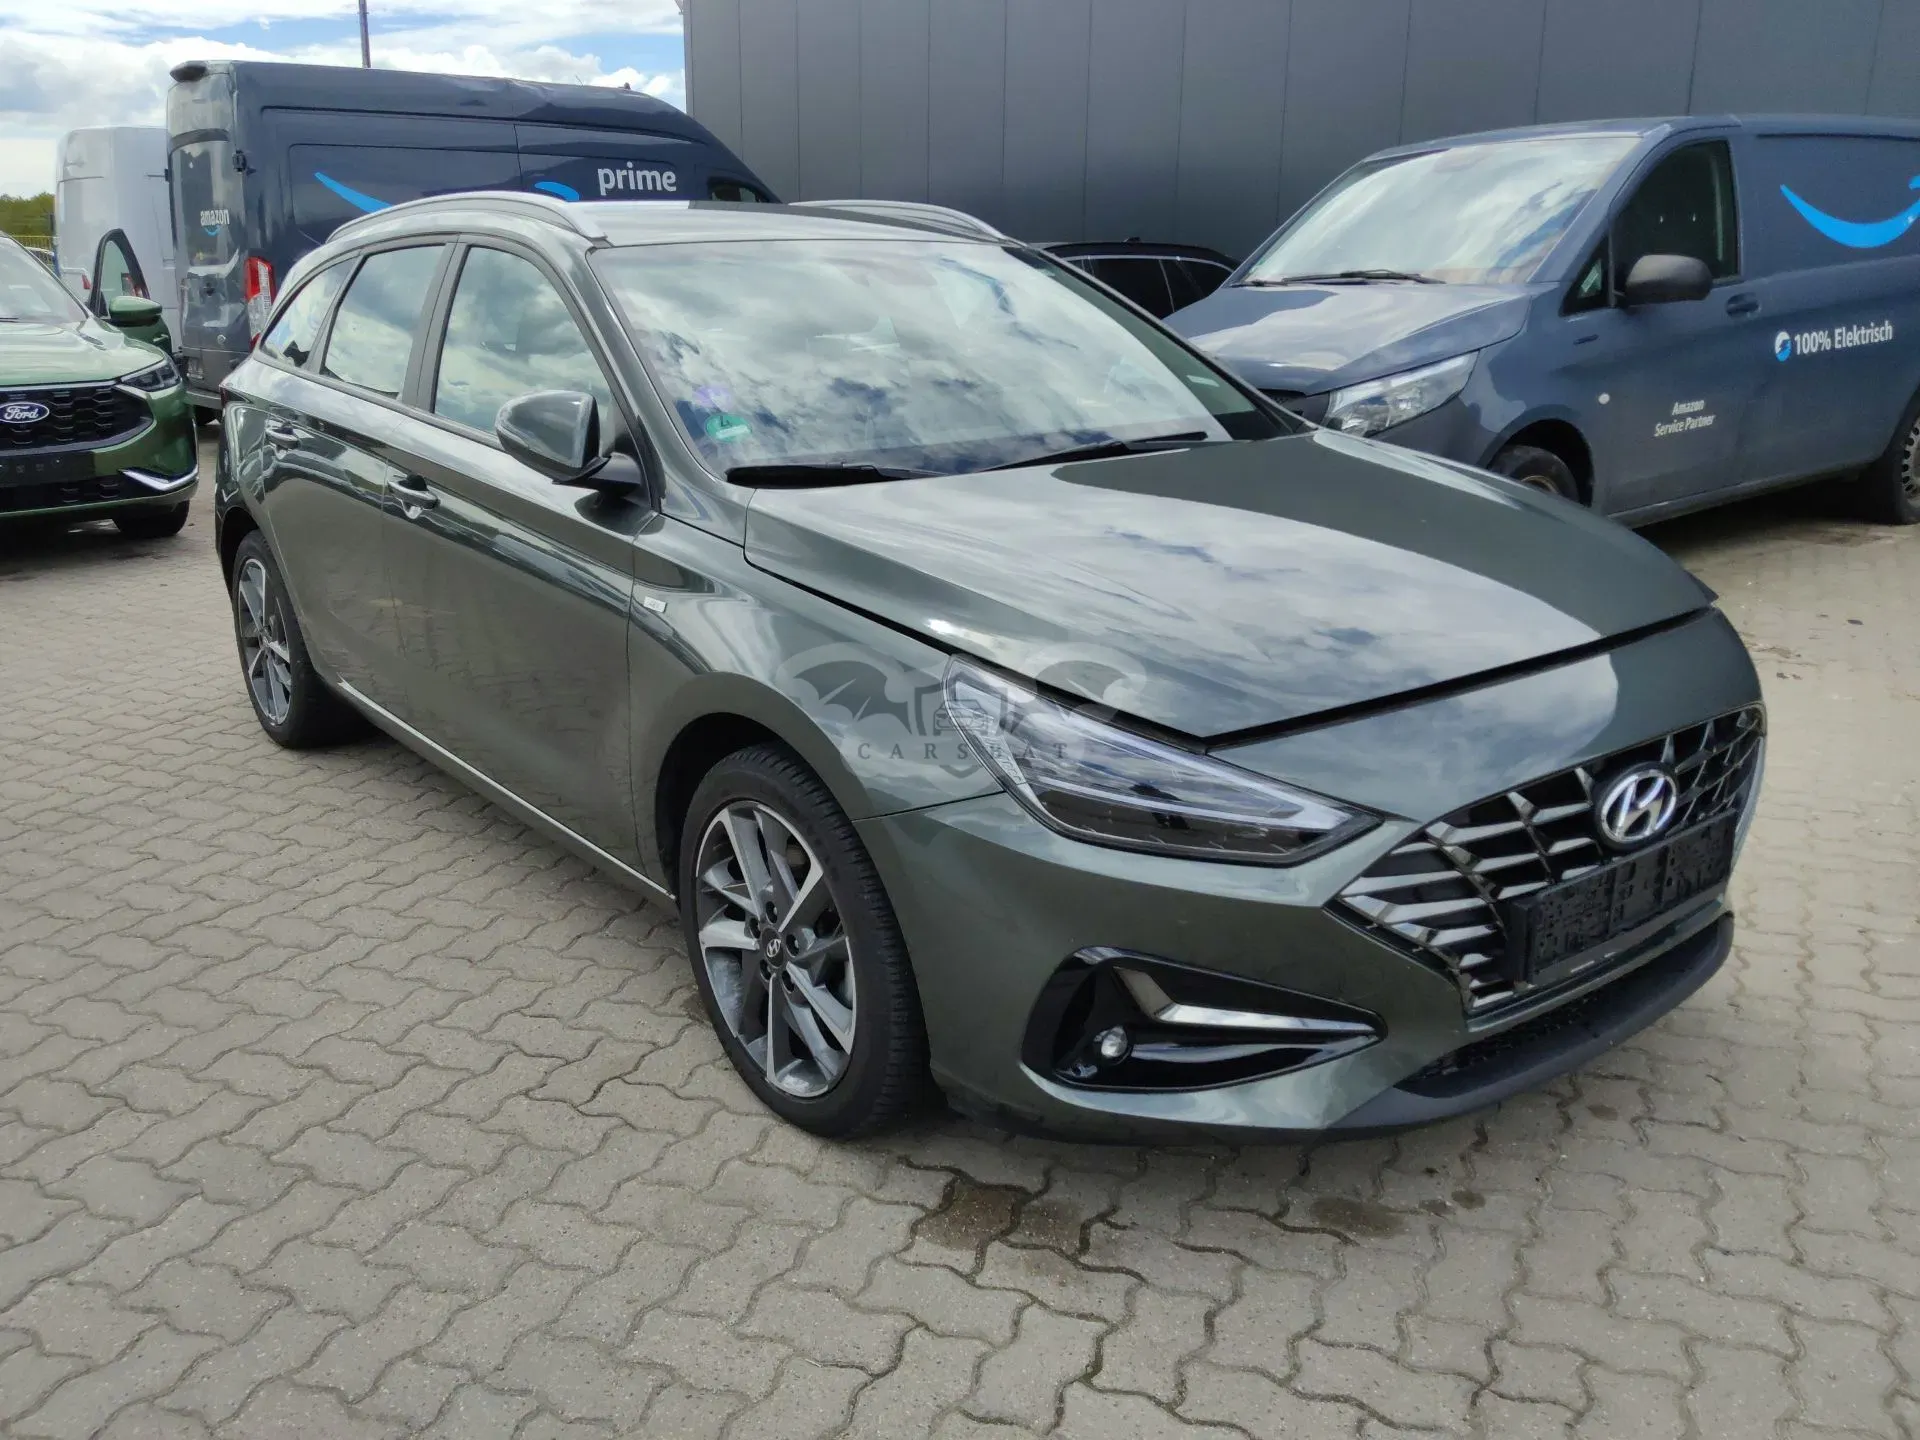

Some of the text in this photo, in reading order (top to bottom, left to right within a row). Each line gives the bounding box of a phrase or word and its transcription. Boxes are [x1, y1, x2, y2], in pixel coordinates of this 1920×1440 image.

[597, 161, 677, 196] prime
[200, 209, 230, 226] amazon
[1794, 320, 1893, 355] 100% Elektrisch
[4, 405, 39, 420] Ford
[1671, 400, 1705, 415] Amazon
[1654, 415, 1716, 437] Service Partner
